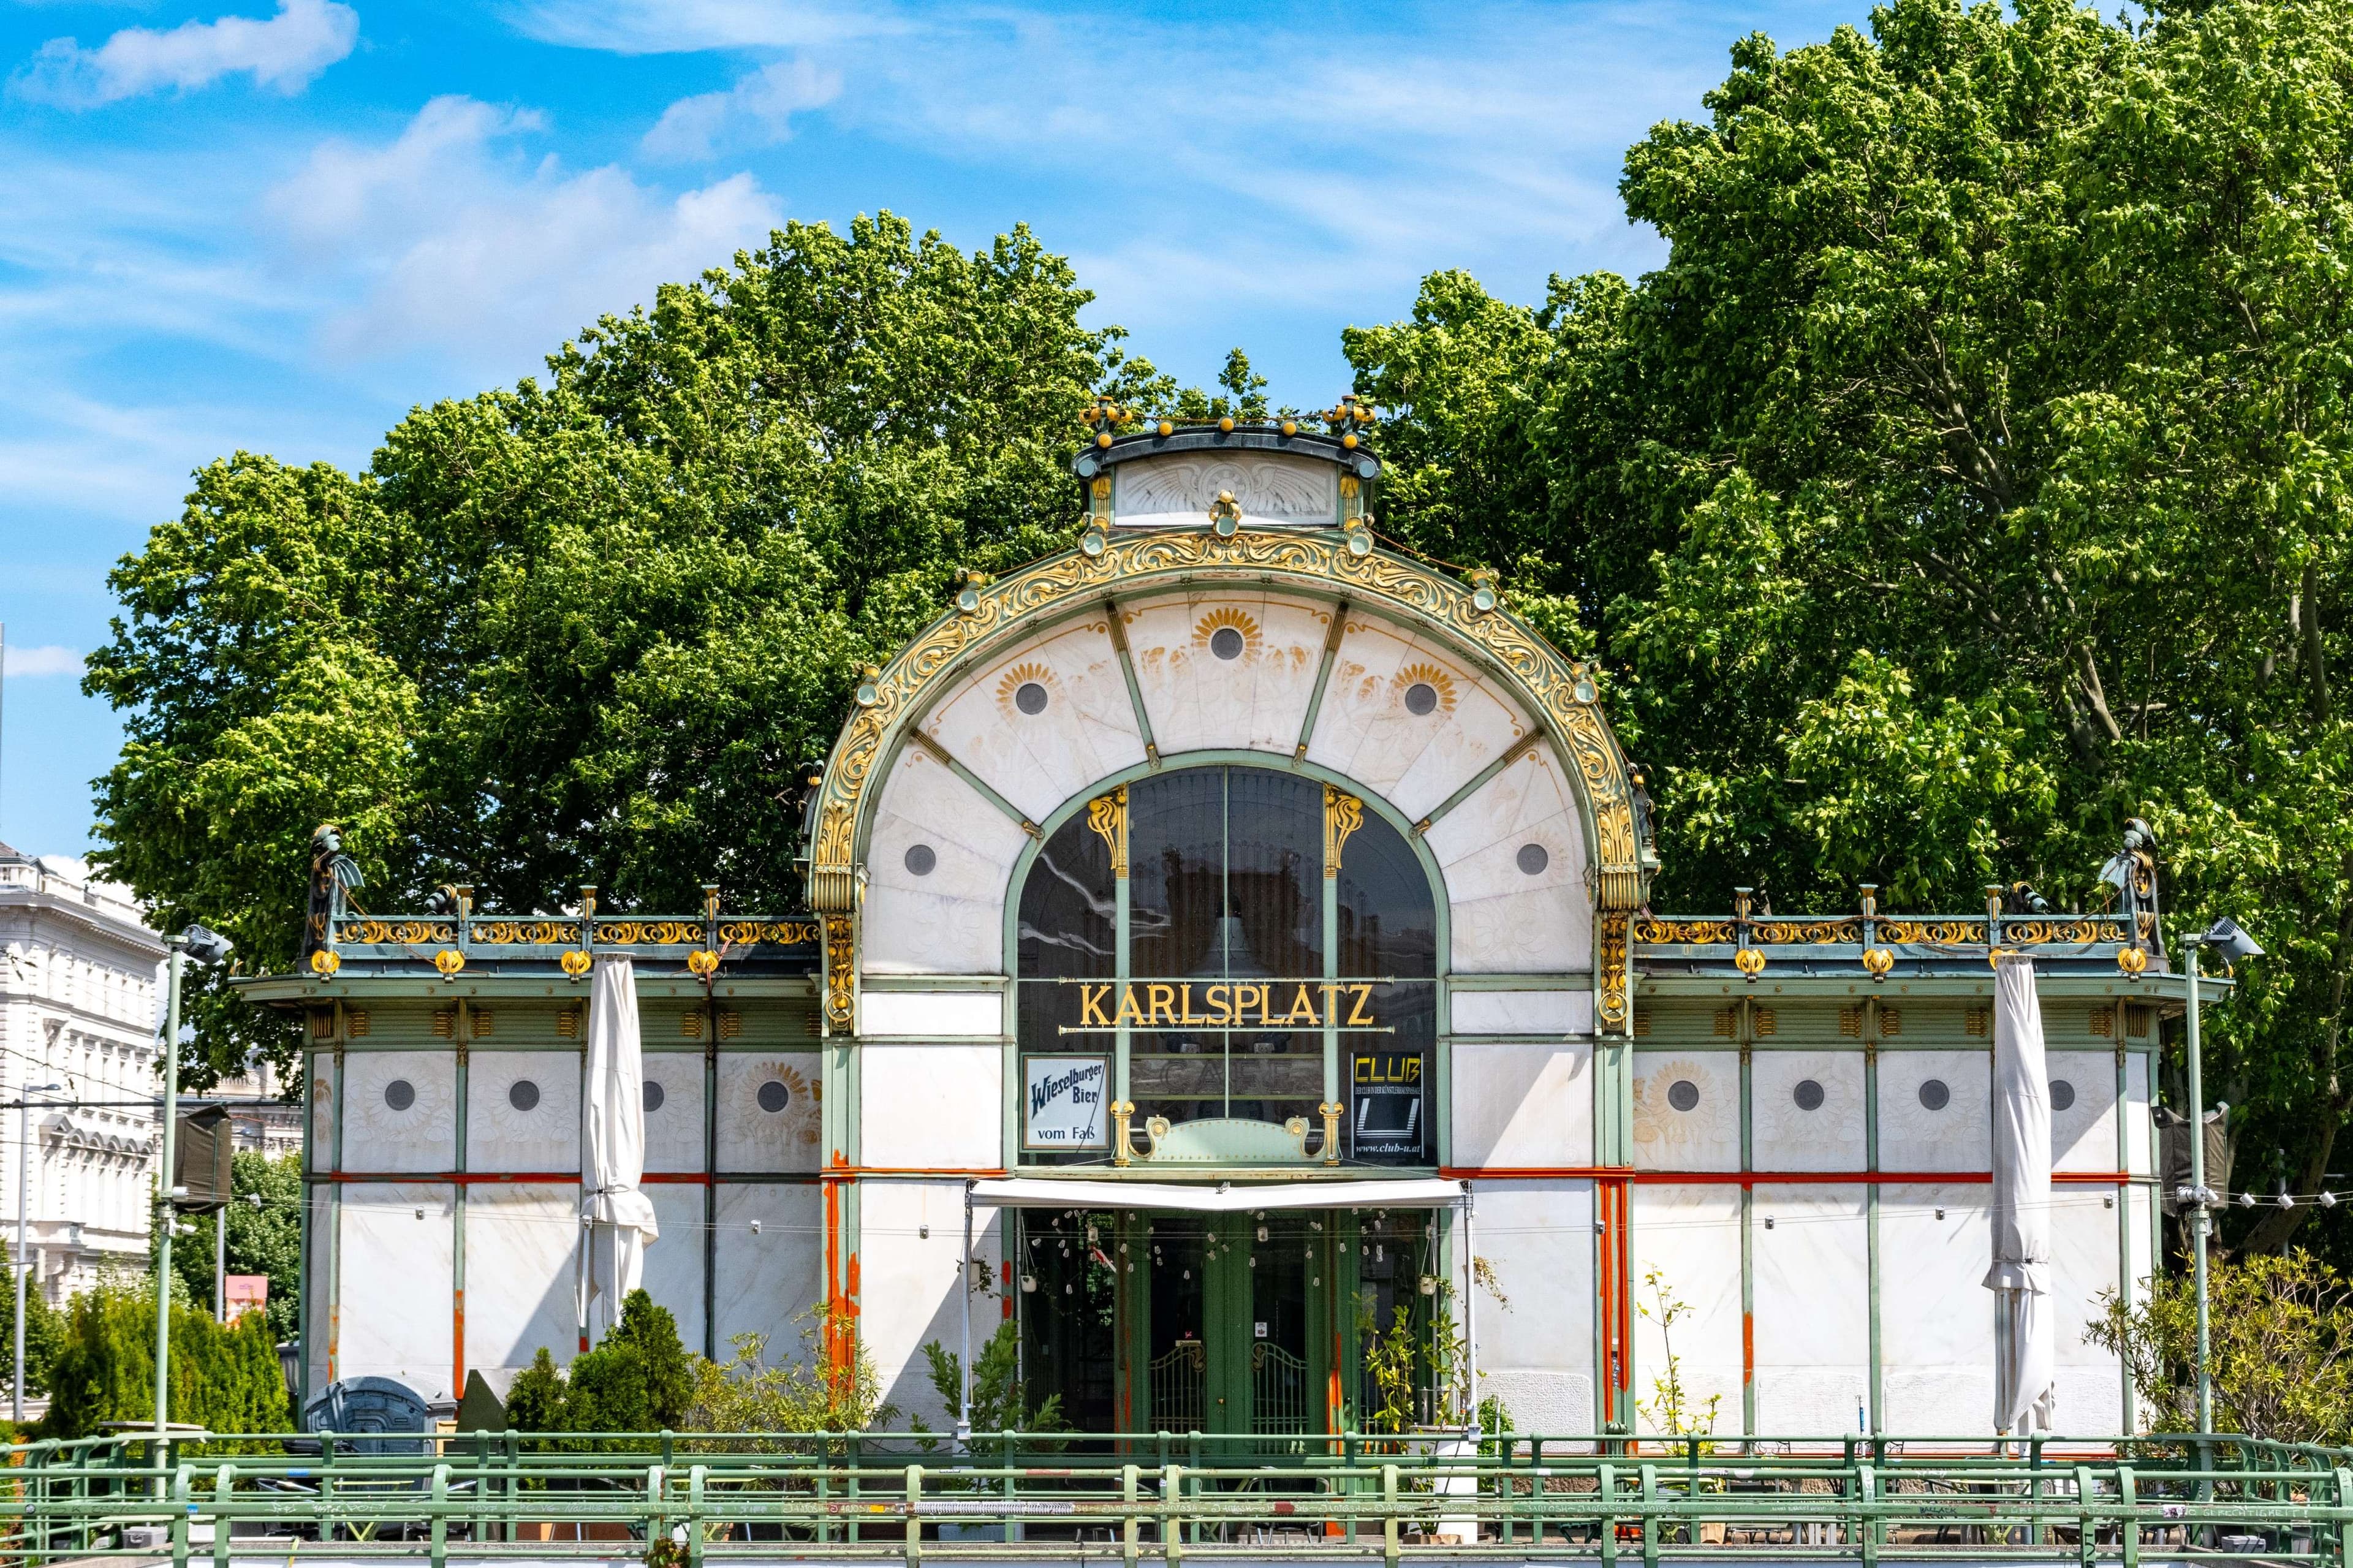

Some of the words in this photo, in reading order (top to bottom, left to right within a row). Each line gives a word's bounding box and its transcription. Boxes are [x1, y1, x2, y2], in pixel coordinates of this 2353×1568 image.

[1080, 984, 1374, 1025] KARLSPLATZ
[1355, 1058, 1421, 1082] CLUB
[1031, 1065, 1102, 1120] Wieselburger
[1072, 1086, 1097, 1104] Bier
[1038, 1130, 1066, 1139] vom
[1072, 1126, 1095, 1139] Faß
[1355, 1143, 1421, 1153] www.club-u.at
